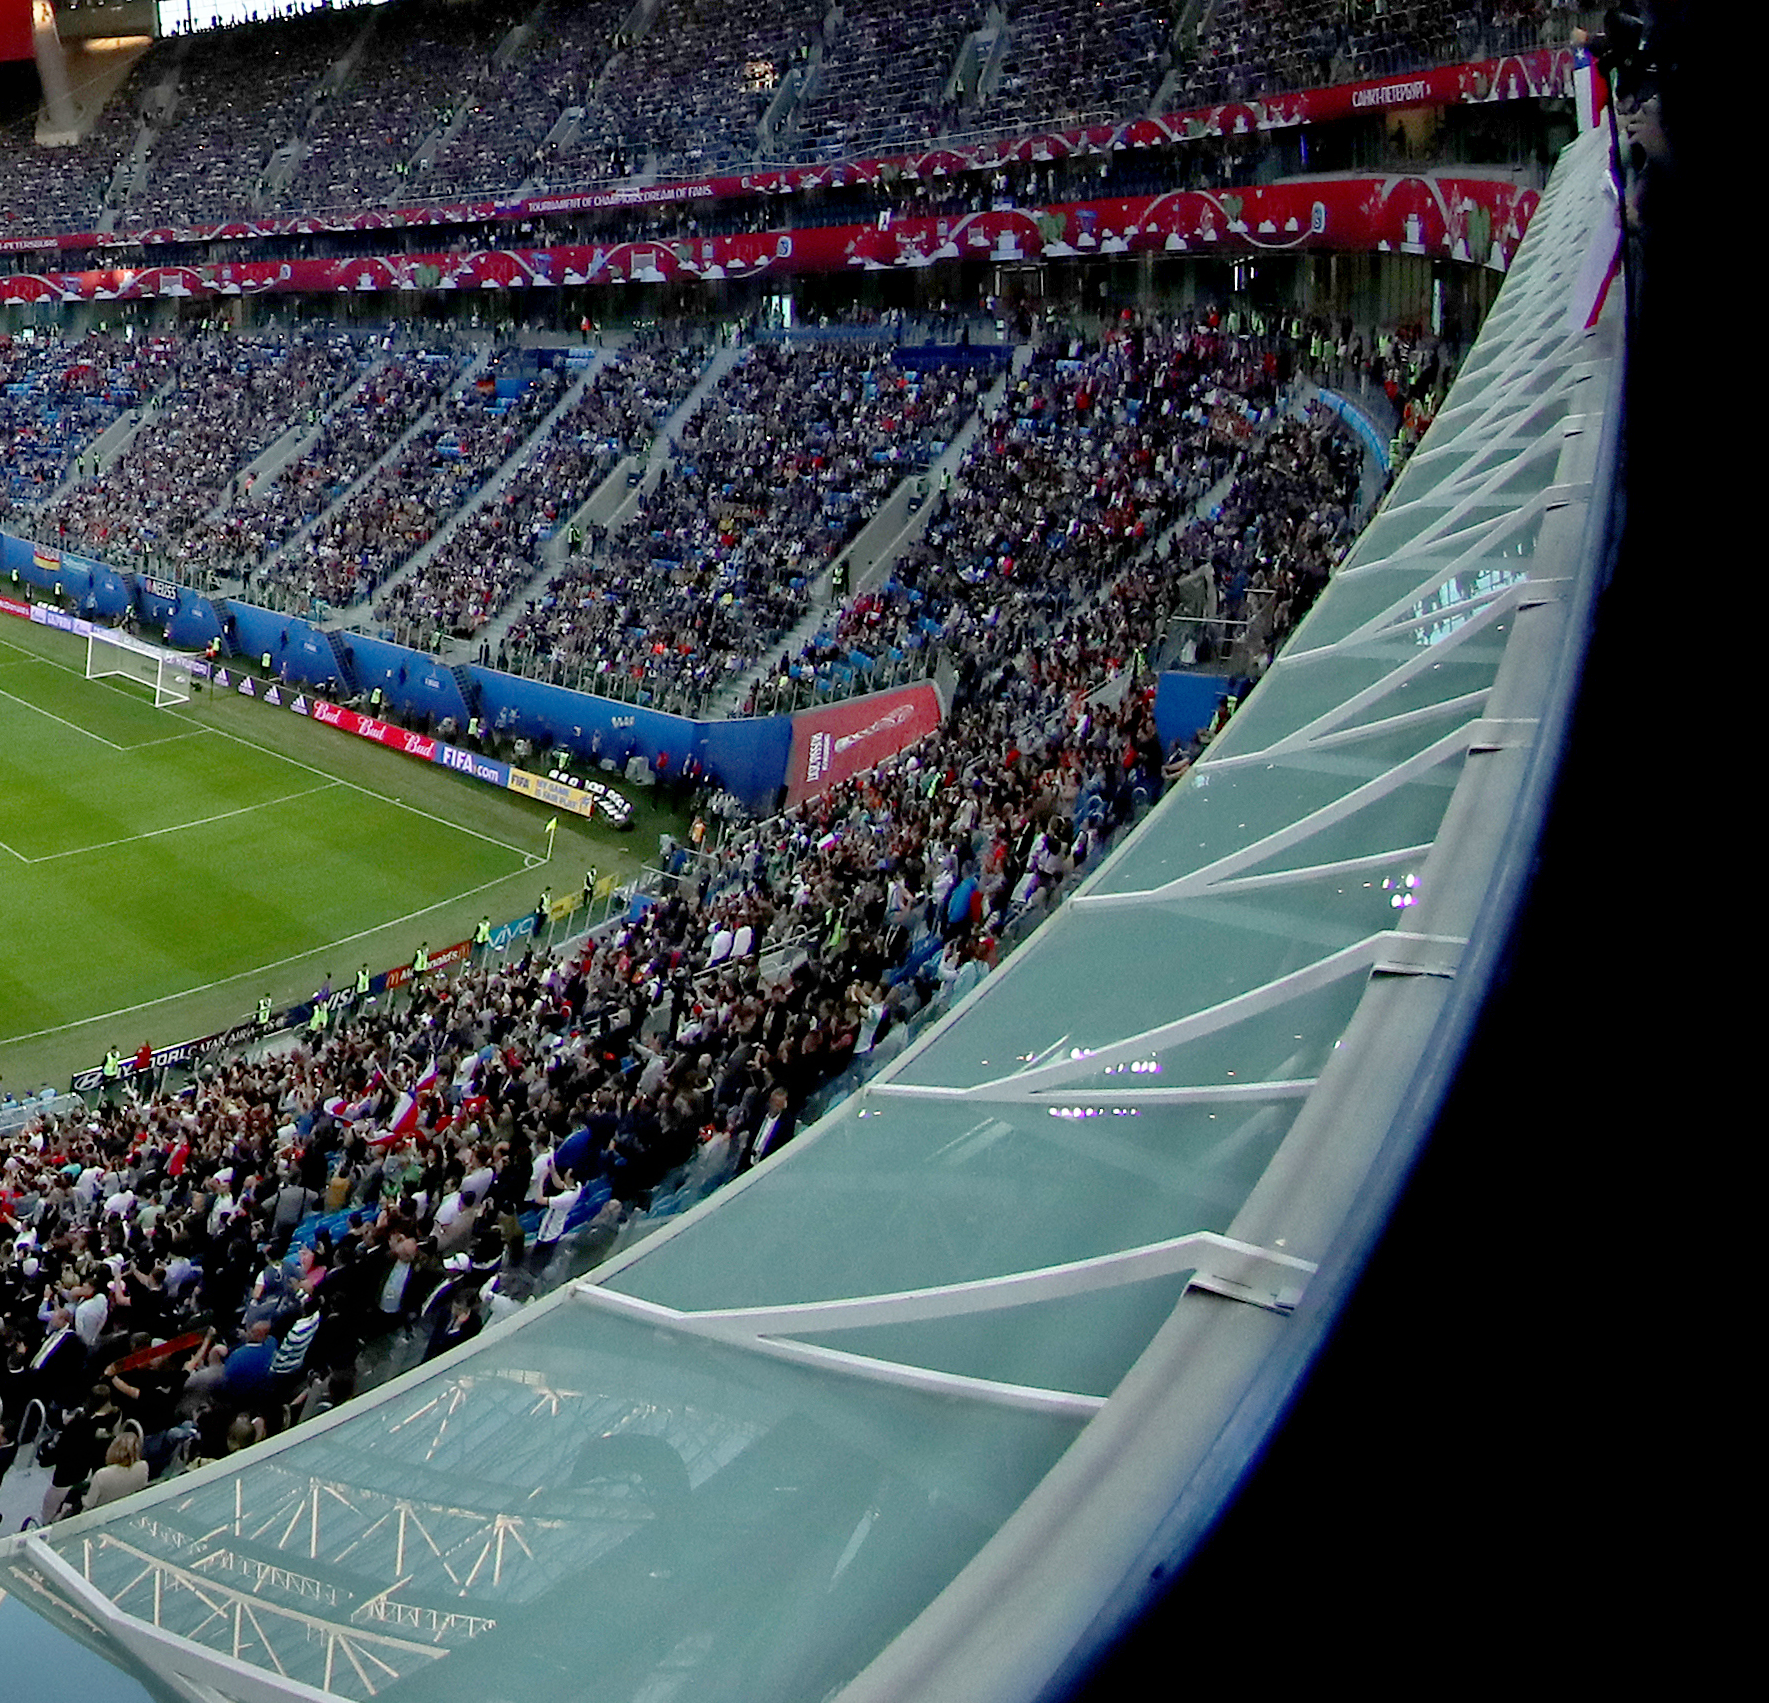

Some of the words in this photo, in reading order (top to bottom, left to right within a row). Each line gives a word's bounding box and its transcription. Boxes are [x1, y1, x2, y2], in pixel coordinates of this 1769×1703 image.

[314, 701, 340, 724] Bud
[358, 718, 386, 741] Bud
[404, 732, 434, 757] Bud
[443, 746, 499, 783] FIFA.com
